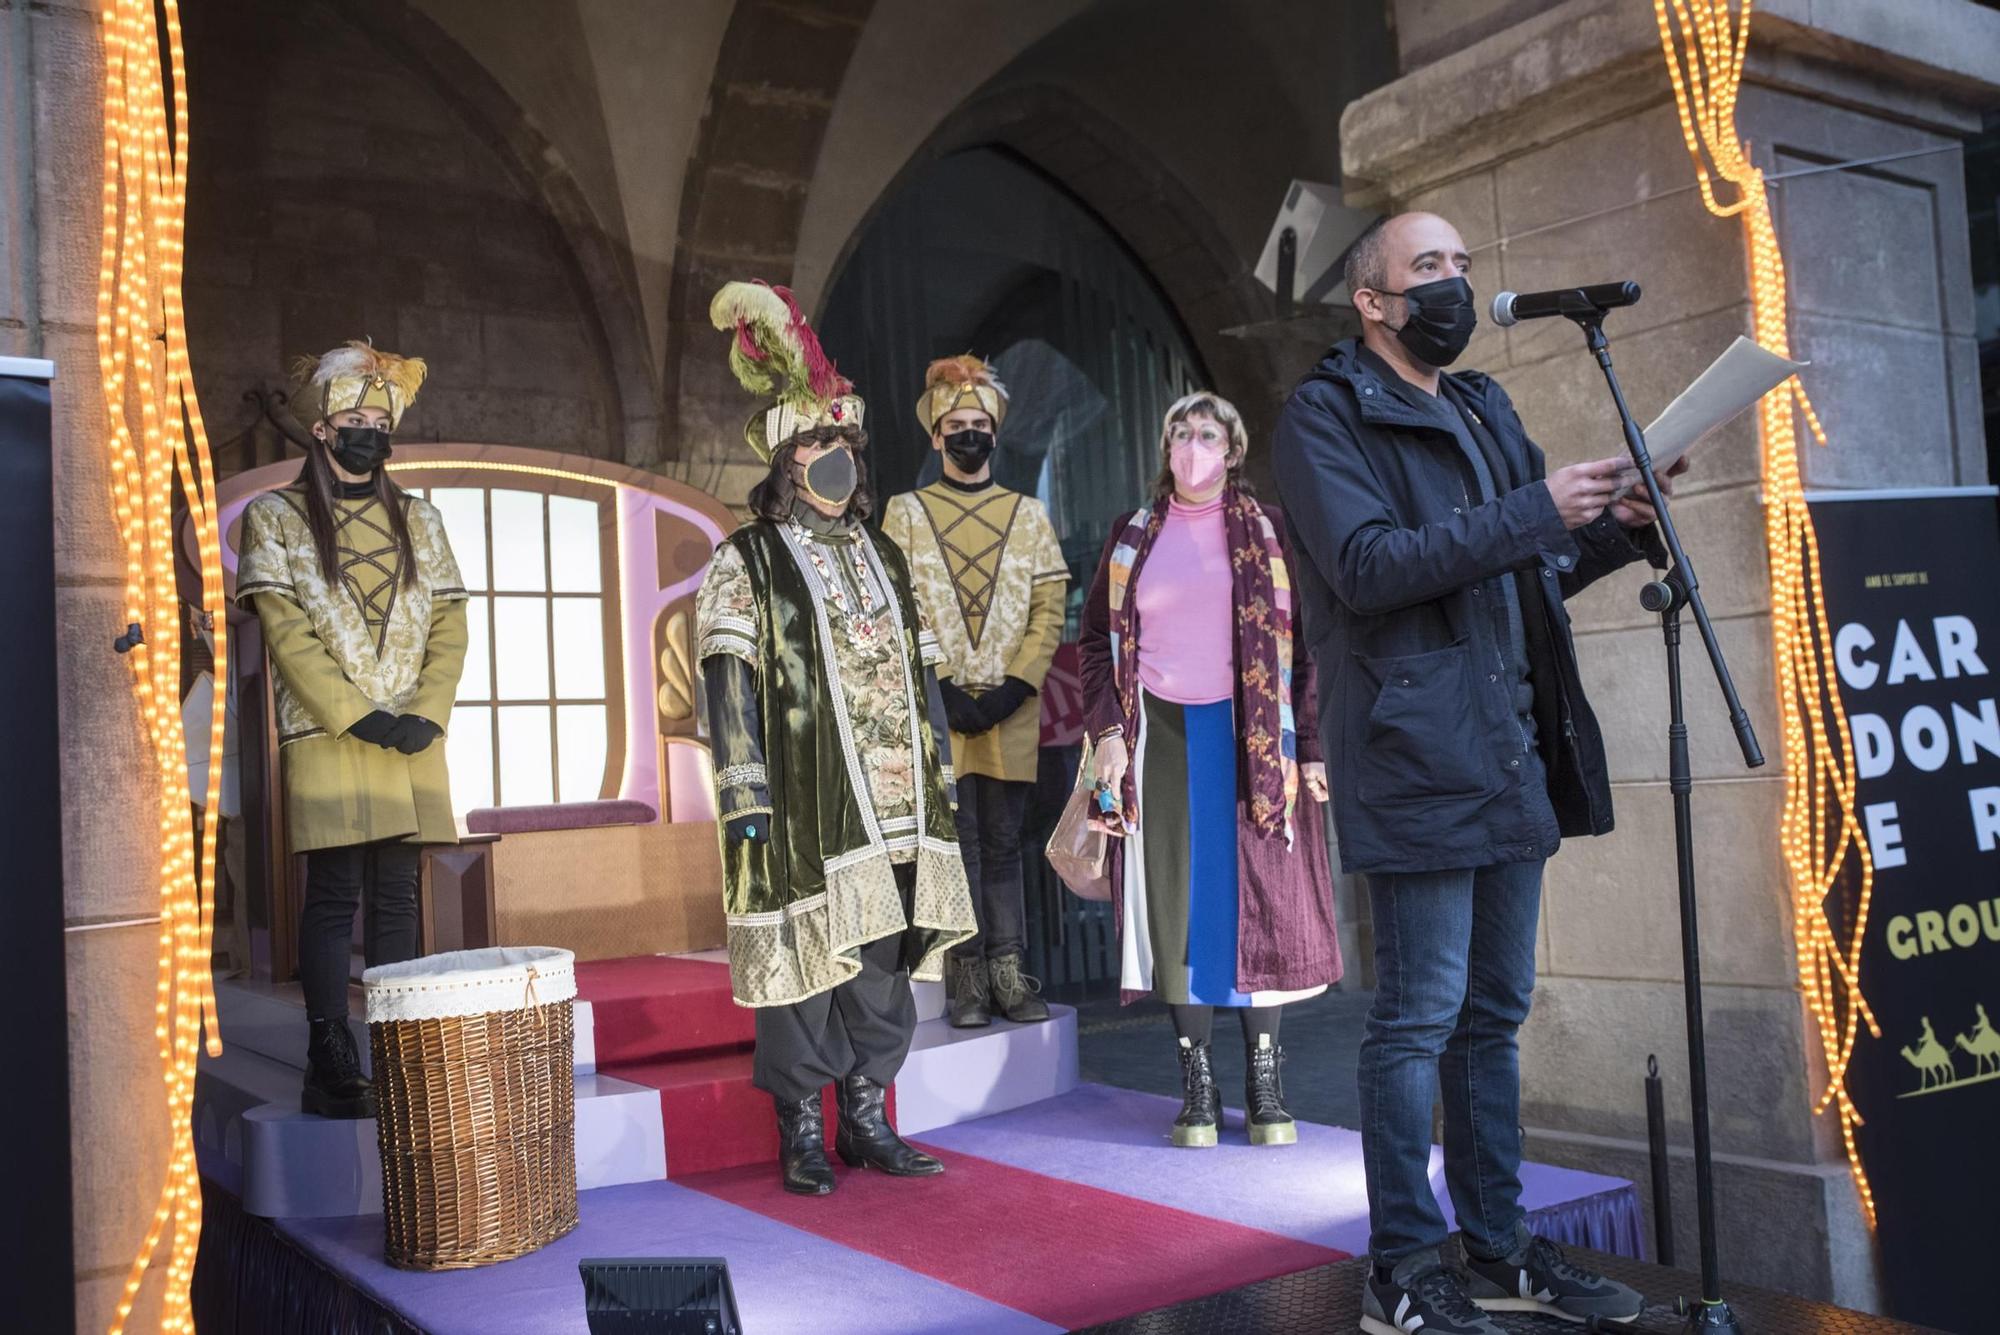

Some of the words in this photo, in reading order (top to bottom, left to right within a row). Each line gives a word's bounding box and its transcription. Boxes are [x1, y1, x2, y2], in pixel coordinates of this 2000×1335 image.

[1834, 615, 1989, 690] CAR
[1850, 698, 2000, 780] DON
[1886, 897, 2000, 960] GROU
